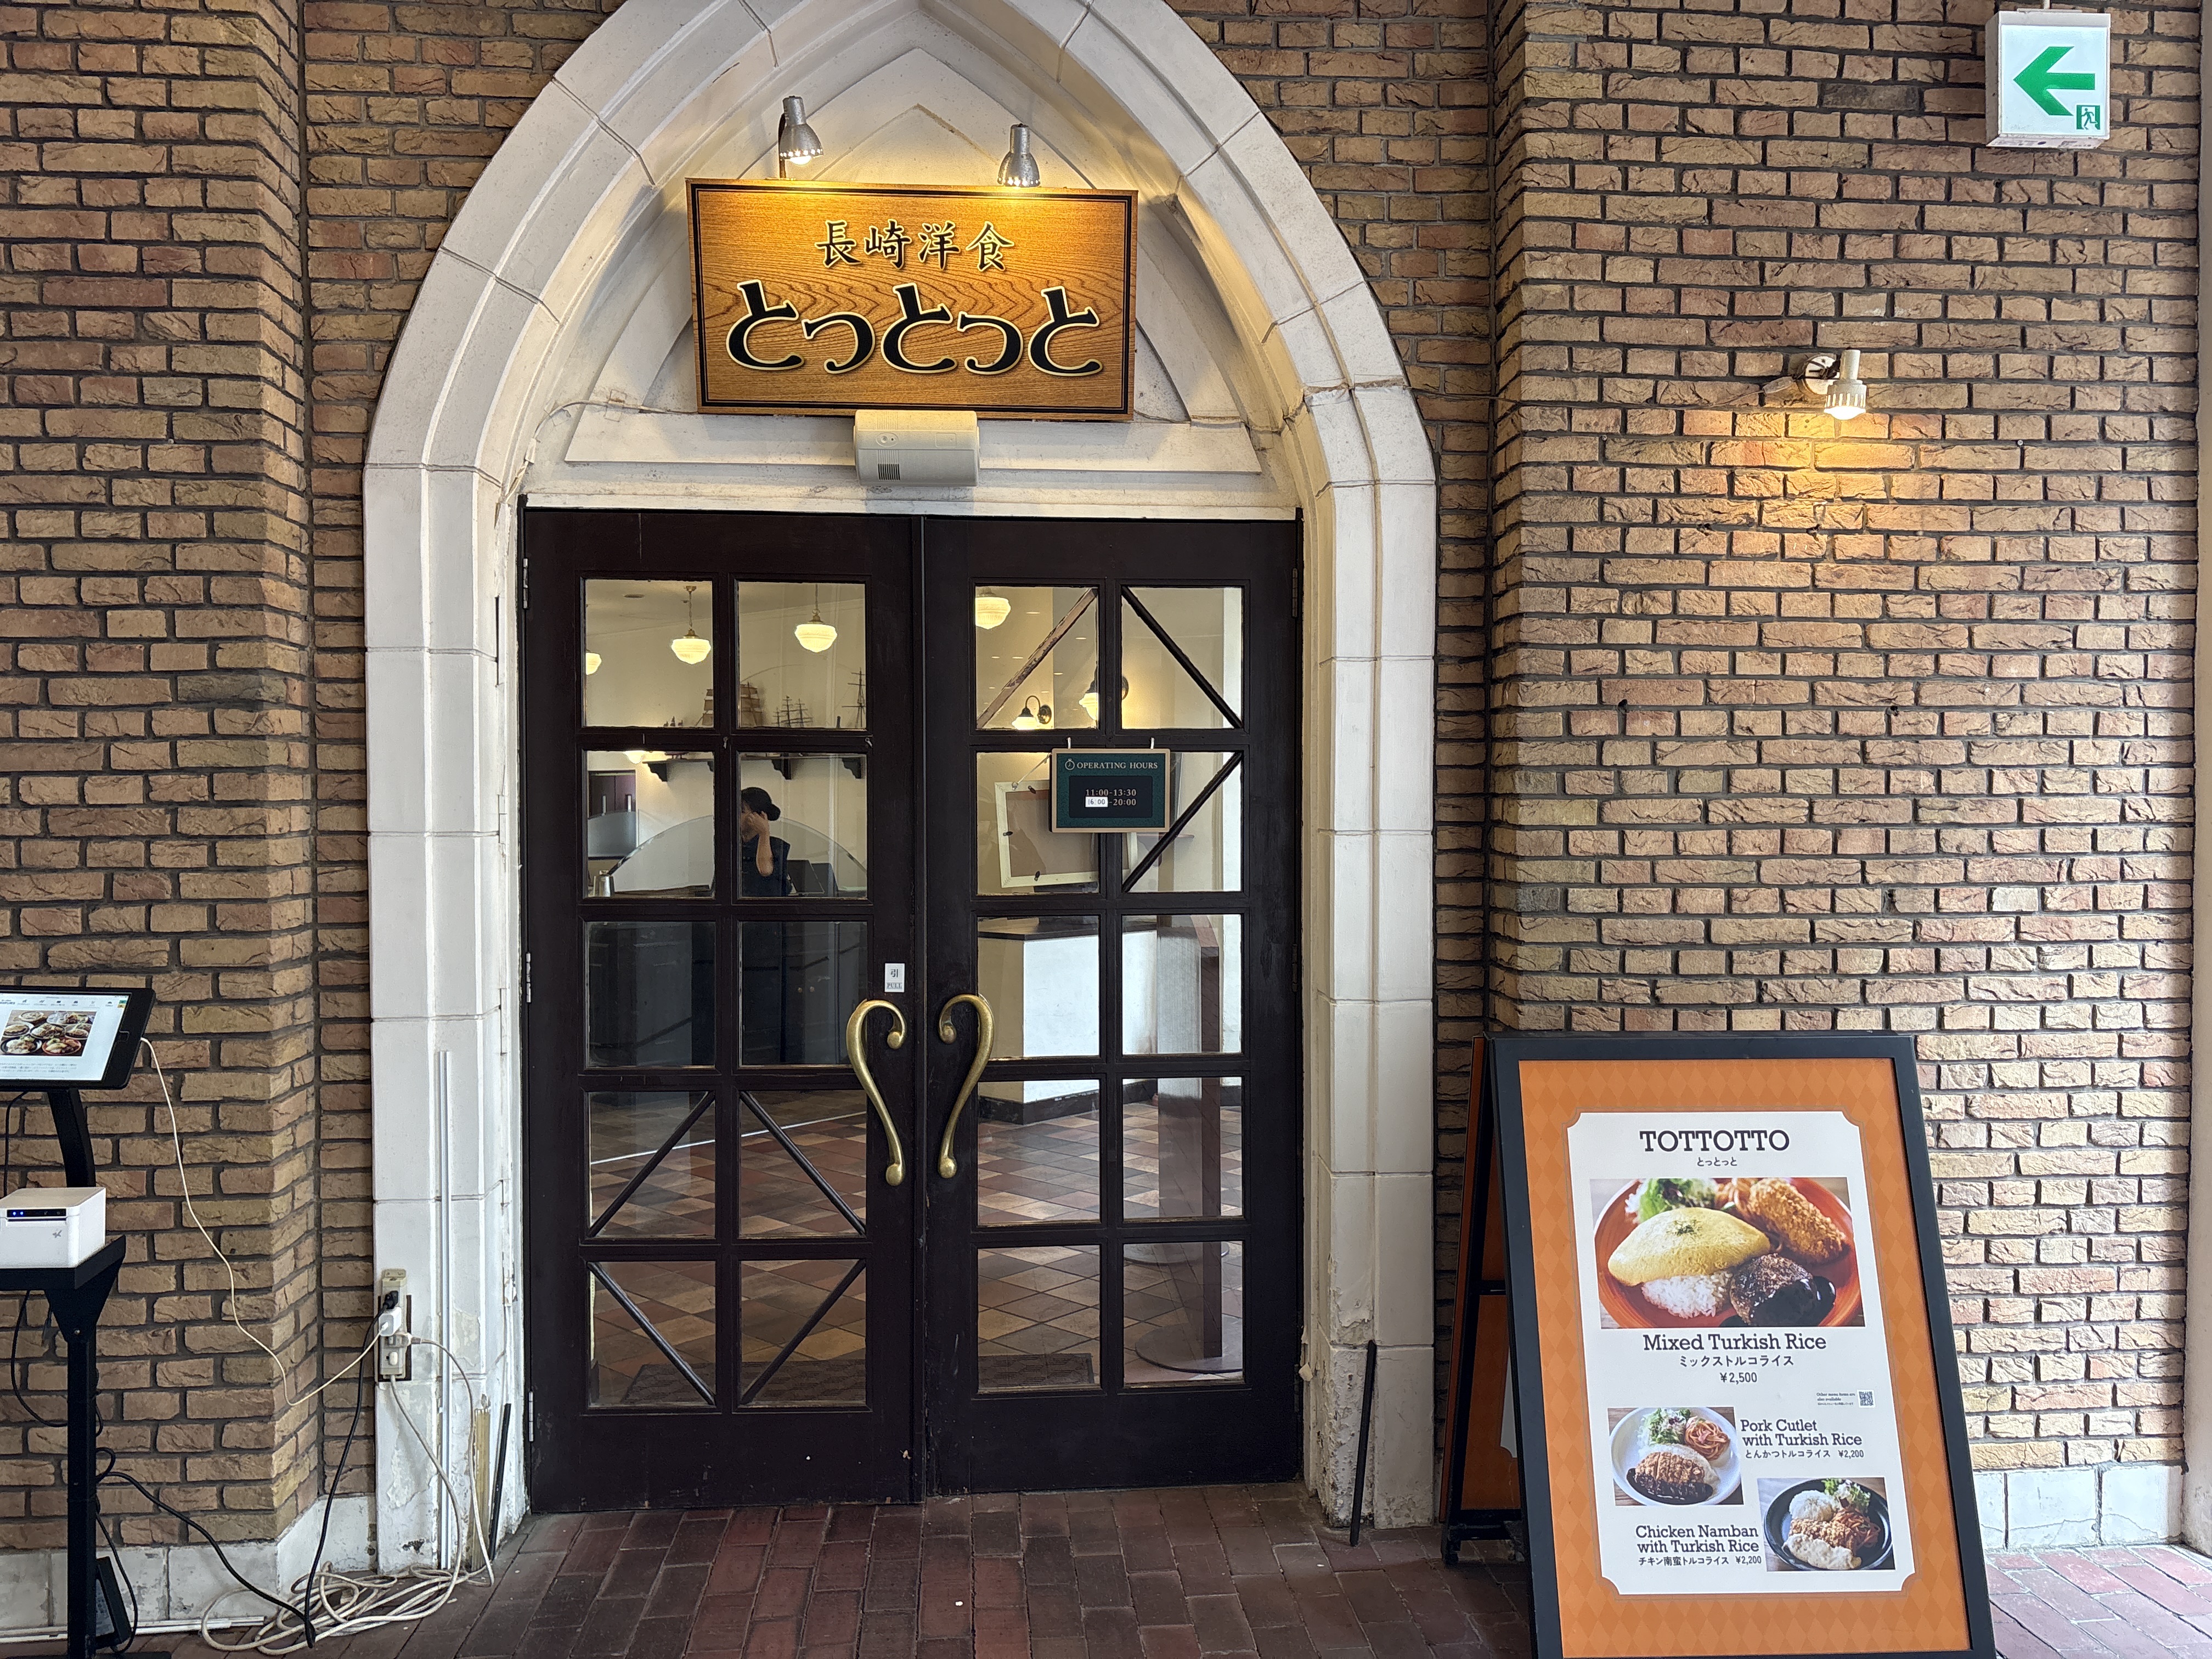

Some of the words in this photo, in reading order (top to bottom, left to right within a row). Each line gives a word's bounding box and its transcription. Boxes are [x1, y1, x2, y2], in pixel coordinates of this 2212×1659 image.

[814, 219, 1014, 272] 長崎洋食
[890, 969, 899, 978] 引
[1639, 1130, 1790, 1152] TOTTOTTO
[1697, 1156, 1737, 1166] とっとっと
[1643, 1334, 1704, 1351] Mixed
[1708, 1333, 1781, 1350] Turkish
[1785, 1333, 1826, 1350] Rice
[1680, 1355, 1794, 1367] ミックストルコライス
[1719, 1372, 1757, 1385] ¥2,500
[1740, 1419, 1773, 1431] Pork
[1776, 1419, 1818, 1431] Cutlet
[1742, 1434, 1773, 1446] with
[1775, 1433, 1829, 1446] Turkish
[1831, 1433, 1862, 1446] Rice
[1745, 1449, 1830, 1458] とんかつトルコライス
[1838, 1449, 1864, 1459] ¥2,200
[1636, 1525, 1695, 1538] Chicken
[1697, 1525, 1758, 1537] Namban
[1637, 1540, 1668, 1553] with
[1671, 1539, 1725, 1552] Turkish
[1728, 1539, 1759, 1552] Rice
[1735, 1556, 1762, 1565] ¥2,200
